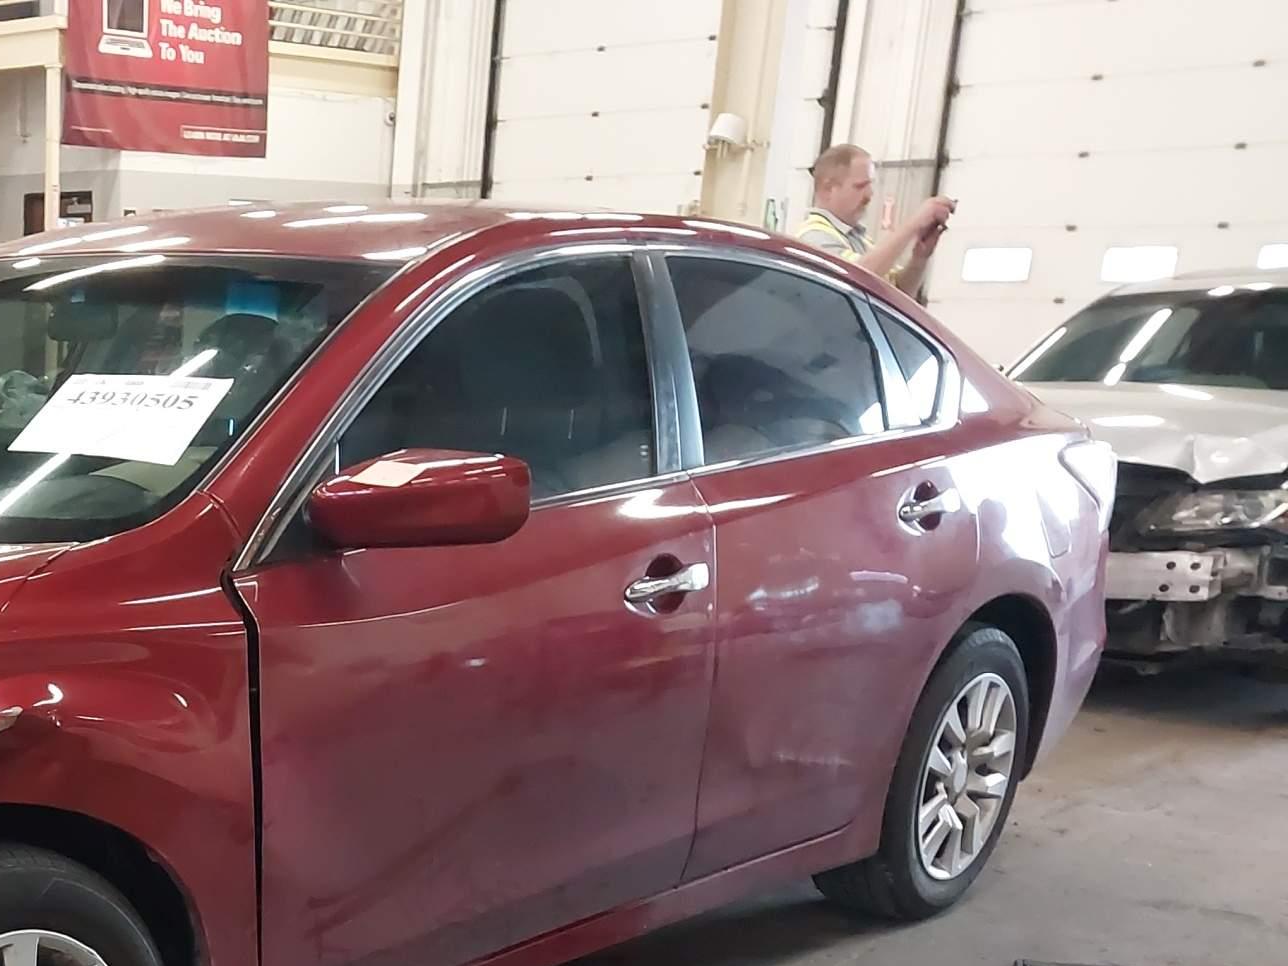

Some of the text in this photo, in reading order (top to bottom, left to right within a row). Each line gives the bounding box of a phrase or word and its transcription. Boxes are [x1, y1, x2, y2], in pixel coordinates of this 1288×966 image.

[184, 0, 222, 24] Bring
[159, 18, 243, 46] The Auction
[158, 42, 205, 64] To You
[67, 390, 199, 410] 43930505
